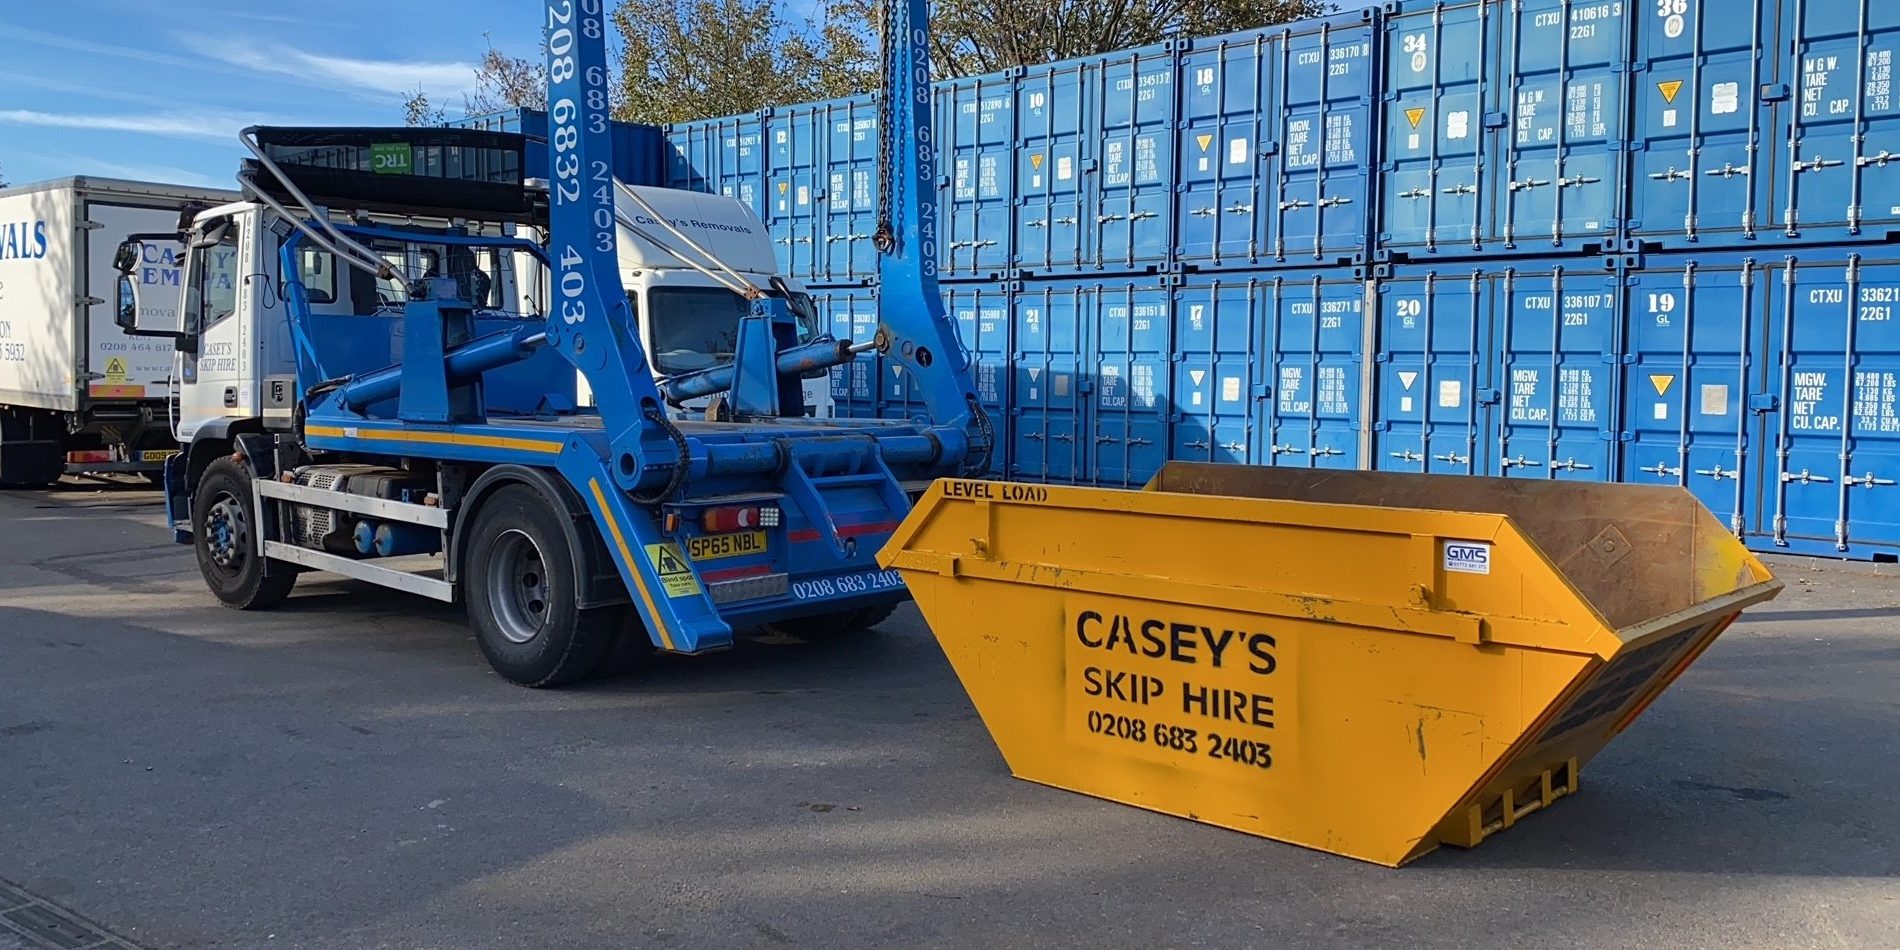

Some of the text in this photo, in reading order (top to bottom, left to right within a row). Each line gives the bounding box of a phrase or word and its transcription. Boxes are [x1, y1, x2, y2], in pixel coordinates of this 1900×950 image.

[1535, 3, 1622, 27] CTXU 410616 3
[1657, 0, 1688, 17] 36
[1571, 26, 1596, 39] 22G1
[1403, 33, 1427, 53] 34
[1298, 52, 1320, 65] CTXU
[1330, 46, 1360, 61] 336170
[913, 29, 928, 104] 0208
[1329, 63, 1350, 76] 22G1
[1196, 68, 1214, 86] 18
[1805, 72, 1828, 86] TARE
[585, 66, 606, 134] 683
[1030, 92, 1044, 109] 10
[1138, 89, 1155, 101] 22G1
[1804, 88, 1822, 101] NET
[1518, 104, 1536, 117] TARE
[1517, 117, 1532, 130] NET
[1289, 132, 1308, 144] TARE
[553, 98, 580, 206] 6832
[918, 125, 931, 181] 683
[1288, 144, 1303, 155] NET
[375, 153, 407, 168] TRC
[591, 160, 614, 253] 2403
[690, 219, 752, 235] Removals
[921, 202, 936, 276] 2403
[560, 244, 586, 325] 403
[1525, 294, 1614, 309] CTXU 336107 7
[1648, 293, 1675, 312] 19
[1810, 289, 1843, 303] CTXU
[1109, 307, 1126, 318] CTXU
[1134, 305, 1158, 316] 336151
[1190, 305, 1204, 320] 17
[1291, 303, 1312, 315] CTXU
[1322, 301, 1351, 312] 336271
[1396, 299, 1421, 316] 20
[1860, 306, 1891, 320] 22G1
[1026, 309, 1039, 323] 21
[1322, 317, 1341, 328] 22G1
[1403, 316, 1415, 325] GL
[1564, 313, 1588, 326] 22G1
[1656, 314, 1671, 323] GL
[1134, 319, 1150, 330] 22G1
[5, 343, 25, 361] 5932
[101, 343, 127, 351] 0208
[131, 344, 151, 353] 464
[204, 342, 232, 355] CASEY'S
[200, 358, 236, 371] SKIP HIRE
[1103, 376, 1117, 386] TARE
[1513, 369, 1539, 382] MGW.
[1794, 372, 1827, 386] MGW.
[1102, 386, 1113, 396] NET
[1281, 379, 1300, 390] TARE
[1513, 382, 1536, 395] TARE
[1280, 390, 1295, 401] NET
[1794, 387, 1823, 400] TARE
[1512, 395, 1530, 407] NET
[1793, 401, 1816, 415] NET
[943, 481, 1048, 502] LEVEL LOAD
[692, 533, 761, 557] SP65 NBL
[1447, 545, 1487, 564] GMS
[792, 569, 905, 600] 0208 683 2403
[1076, 610, 1278, 675] CASEY'S
[1083, 666, 1275, 729] SKIP HIRE
[1087, 710, 1273, 770] 0208 683 2403
